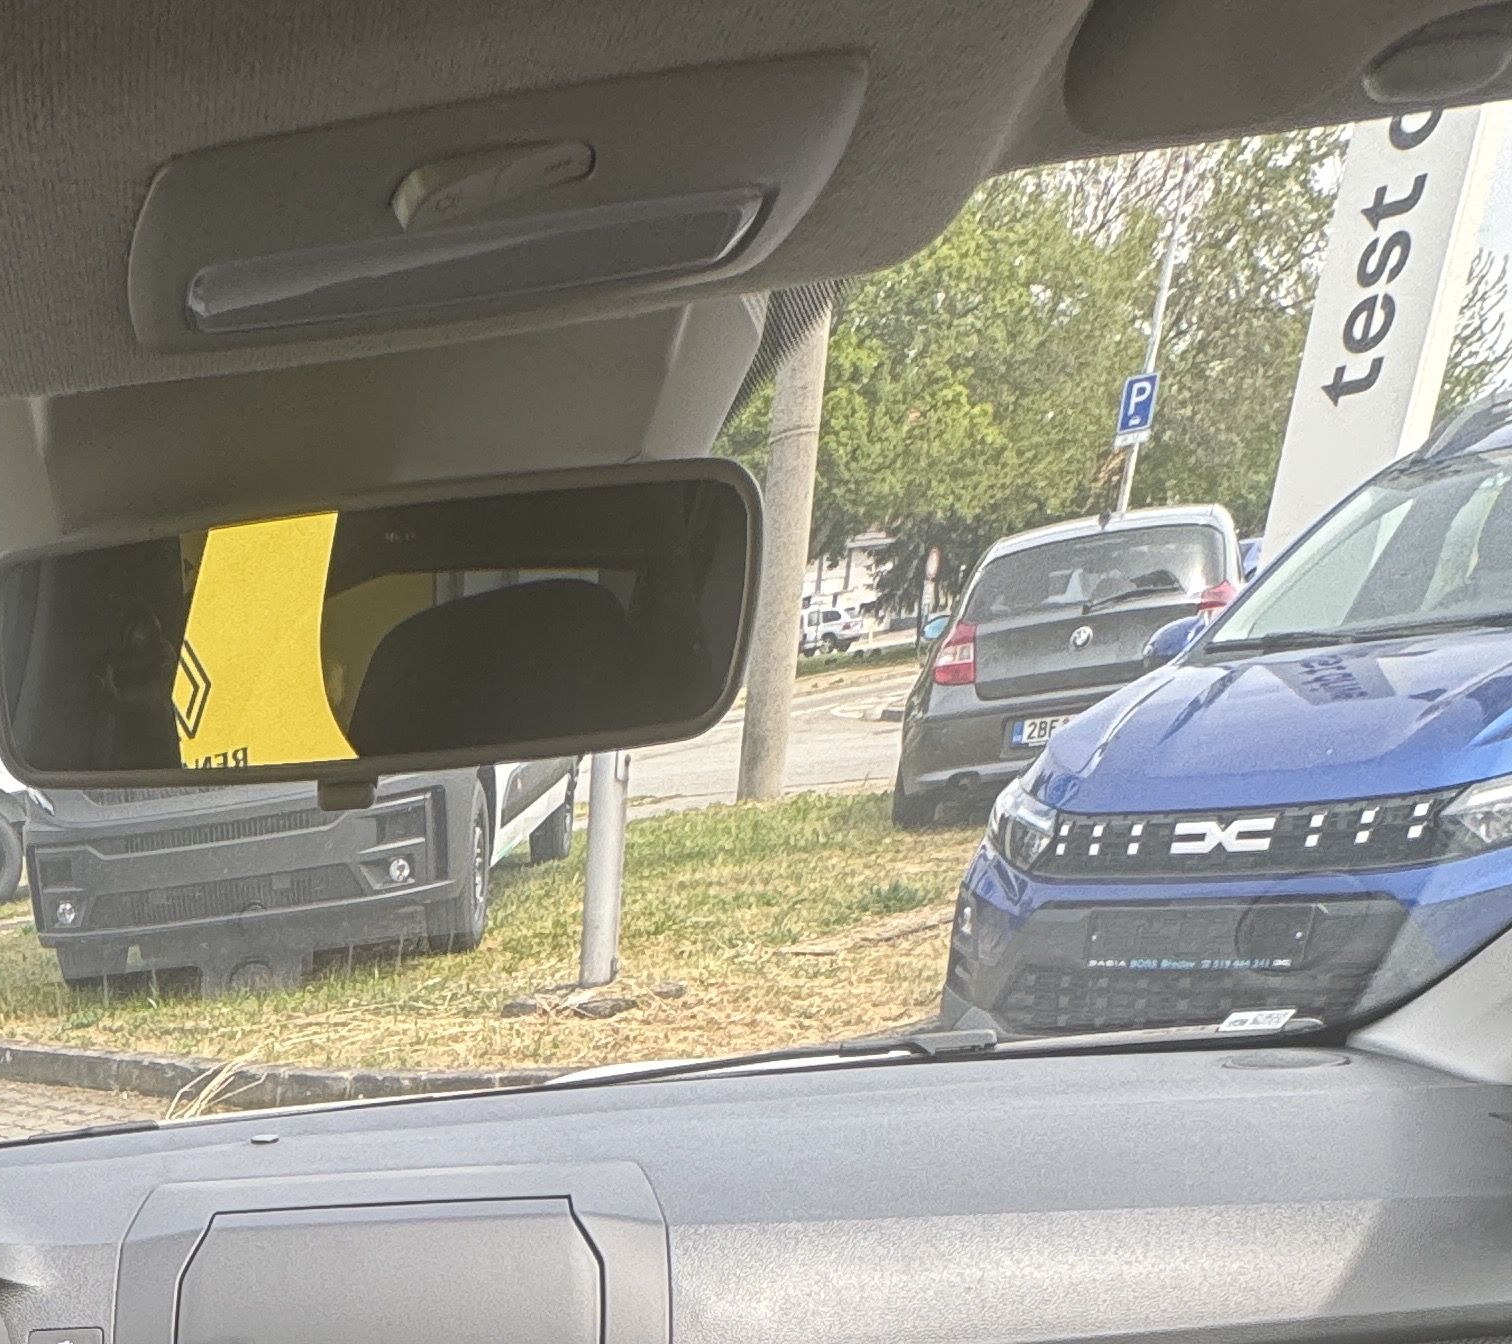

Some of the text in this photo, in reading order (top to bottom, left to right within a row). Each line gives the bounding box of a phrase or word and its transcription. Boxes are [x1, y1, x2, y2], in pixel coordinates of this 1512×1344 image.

[1321, 172, 1428, 407] test
[1127, 381, 1152, 417] P
[1087, 959, 1127, 968] DACIA
